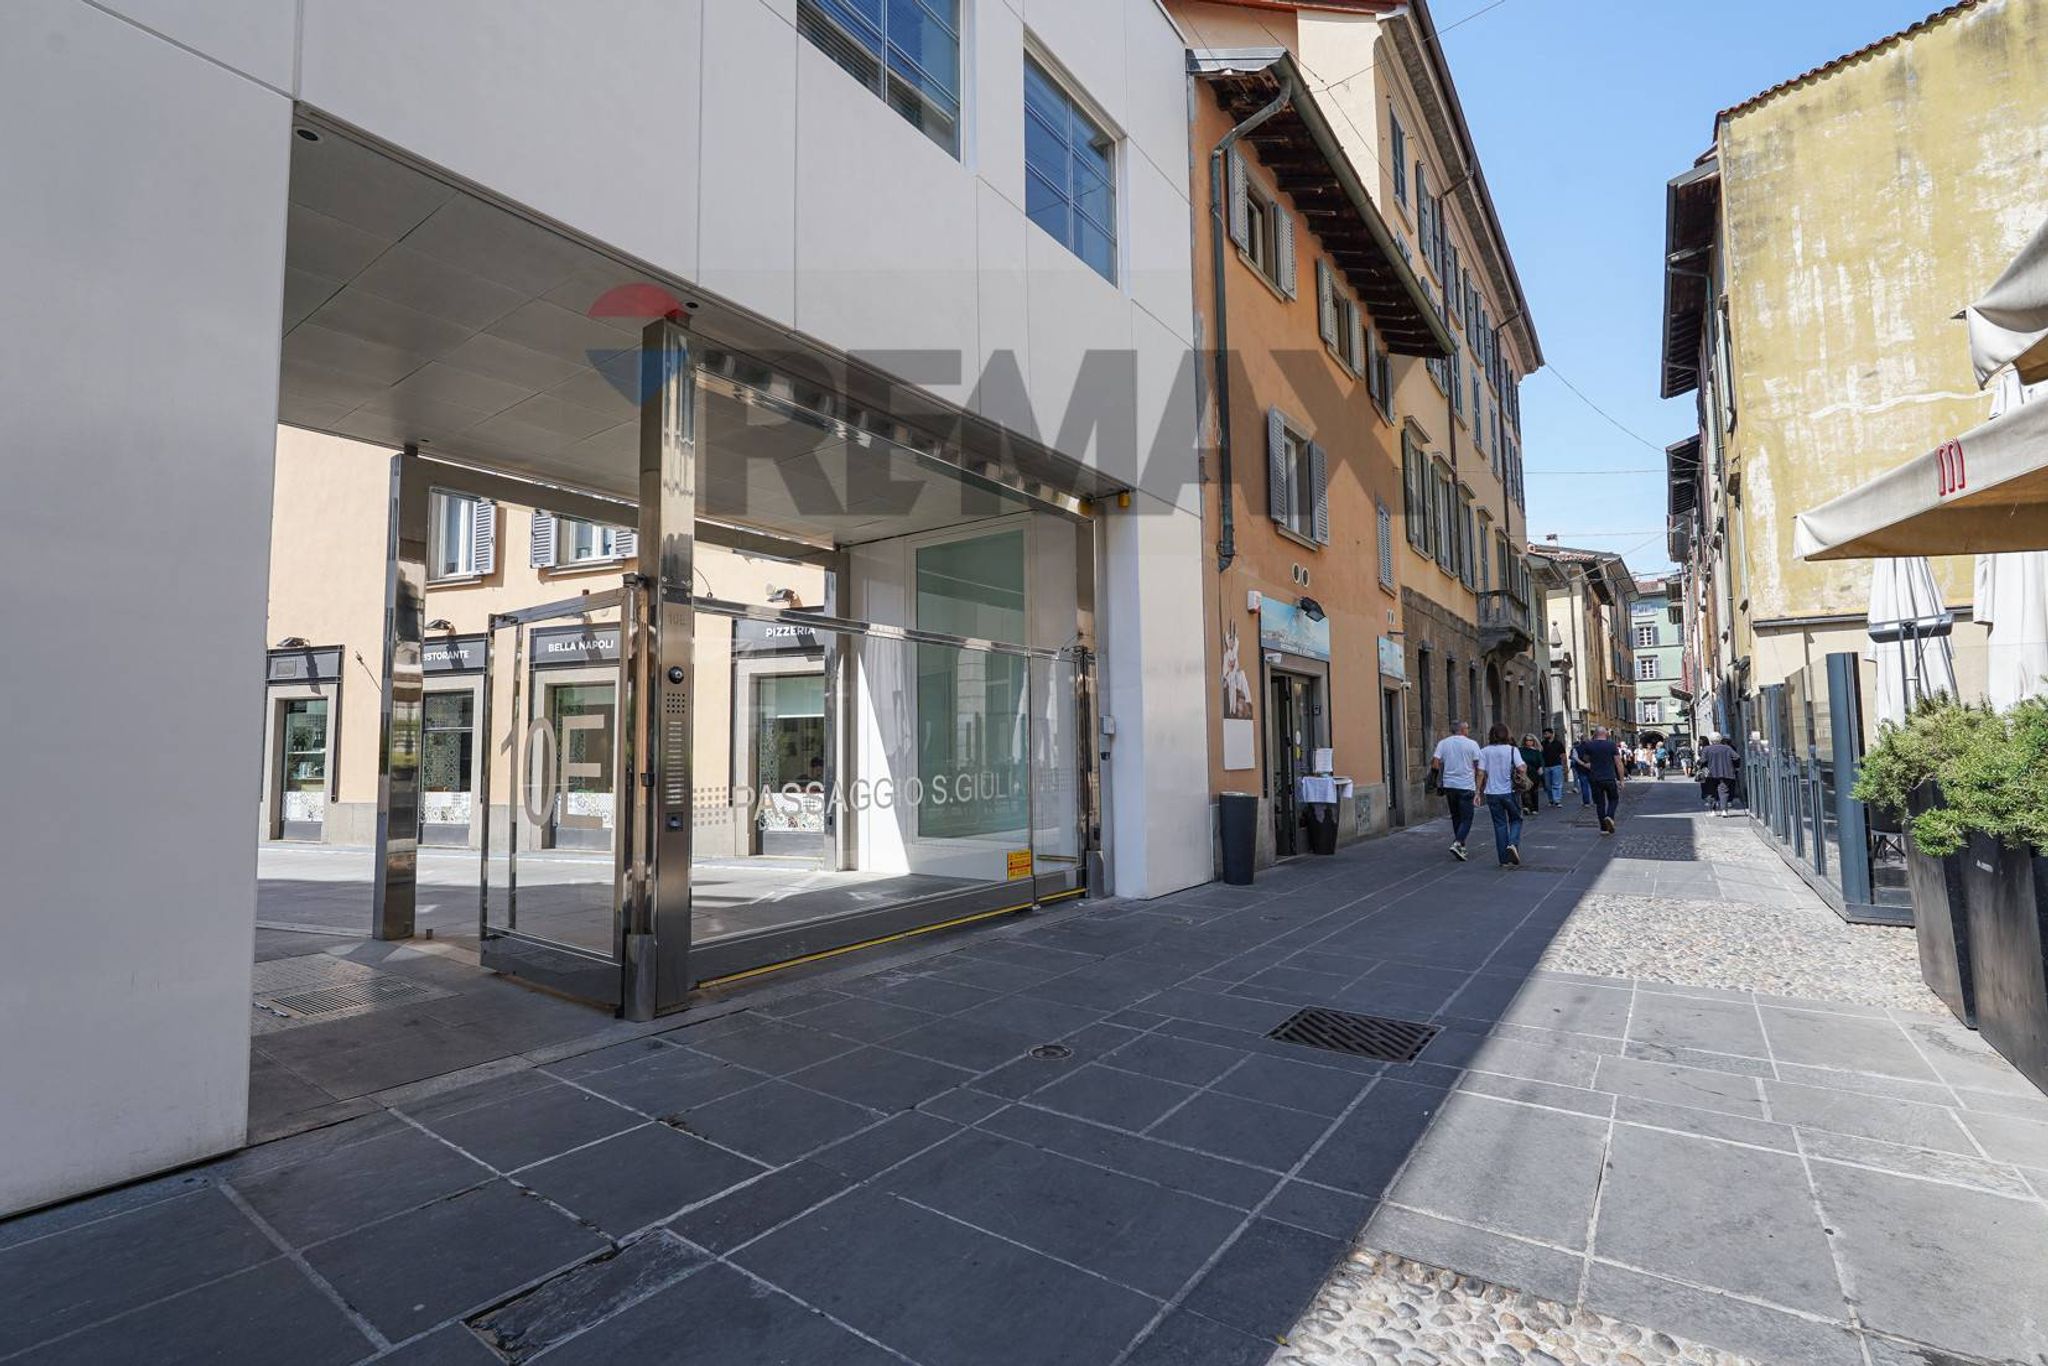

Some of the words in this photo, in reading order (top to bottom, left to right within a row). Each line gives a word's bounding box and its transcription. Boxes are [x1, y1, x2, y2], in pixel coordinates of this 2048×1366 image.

[766, 625, 816, 638] PIZZERIA
[548, 641, 577, 653] BELLA
[579, 639, 614, 651] NAPOLI
[423, 649, 470, 661] ISTORANTE
[500, 714, 605, 829] 10E
[732, 776, 924, 822] PASSAGGIO
